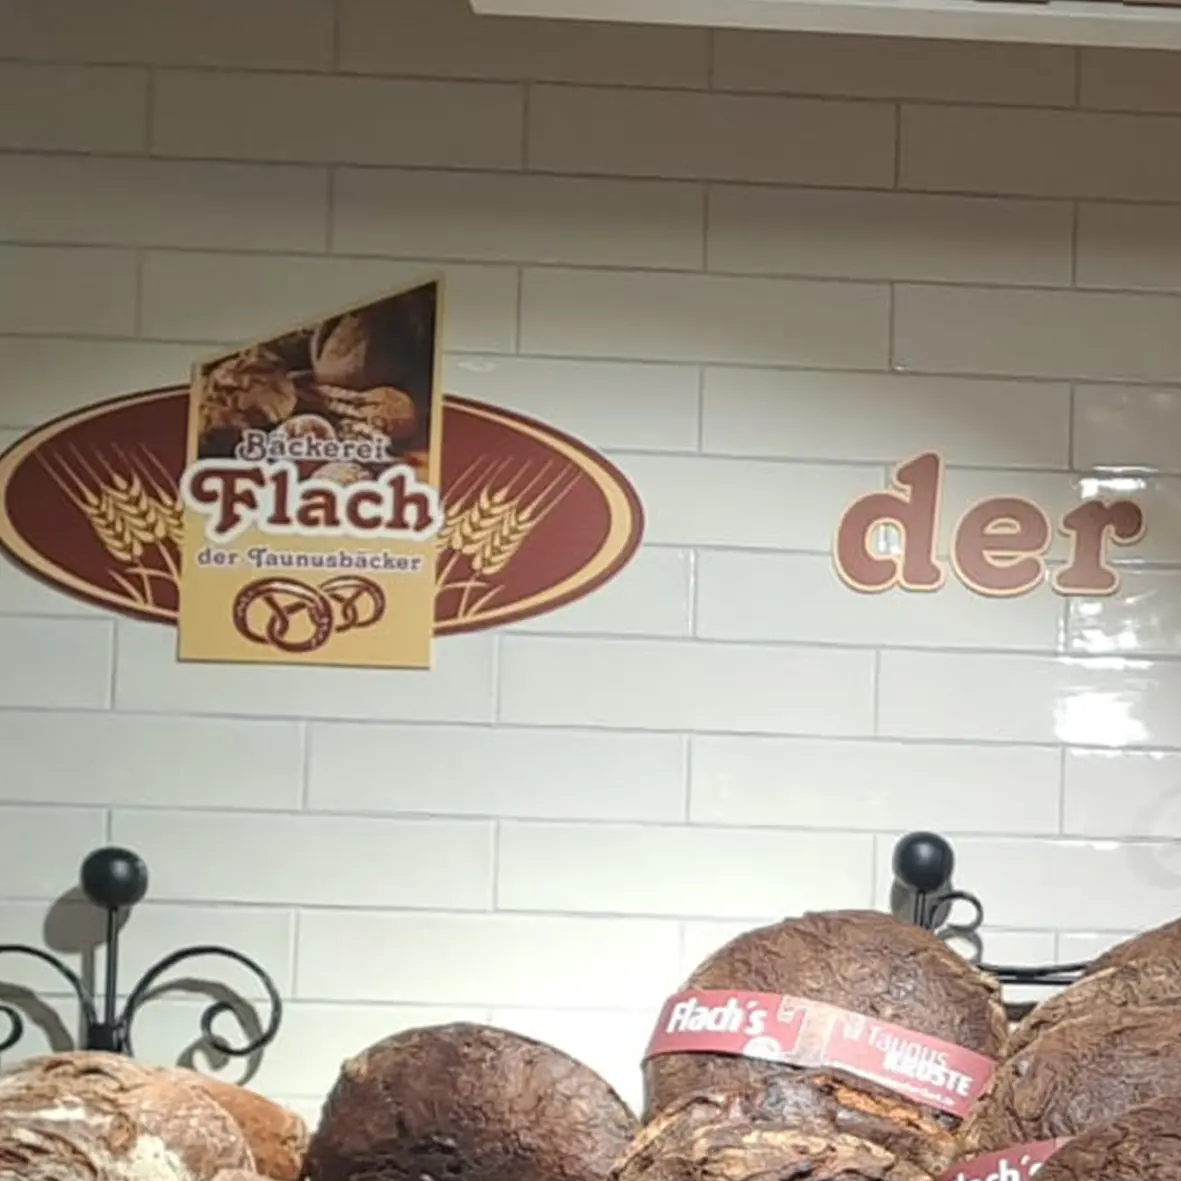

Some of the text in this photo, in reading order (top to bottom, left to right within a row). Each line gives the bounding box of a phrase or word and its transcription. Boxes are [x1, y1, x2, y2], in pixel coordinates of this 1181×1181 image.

[236, 430, 390, 461] Bäckerei
[186, 462, 438, 538] Flach
[833, 450, 1146, 596] der
[198, 547, 423, 572] der Taunusbäcker
